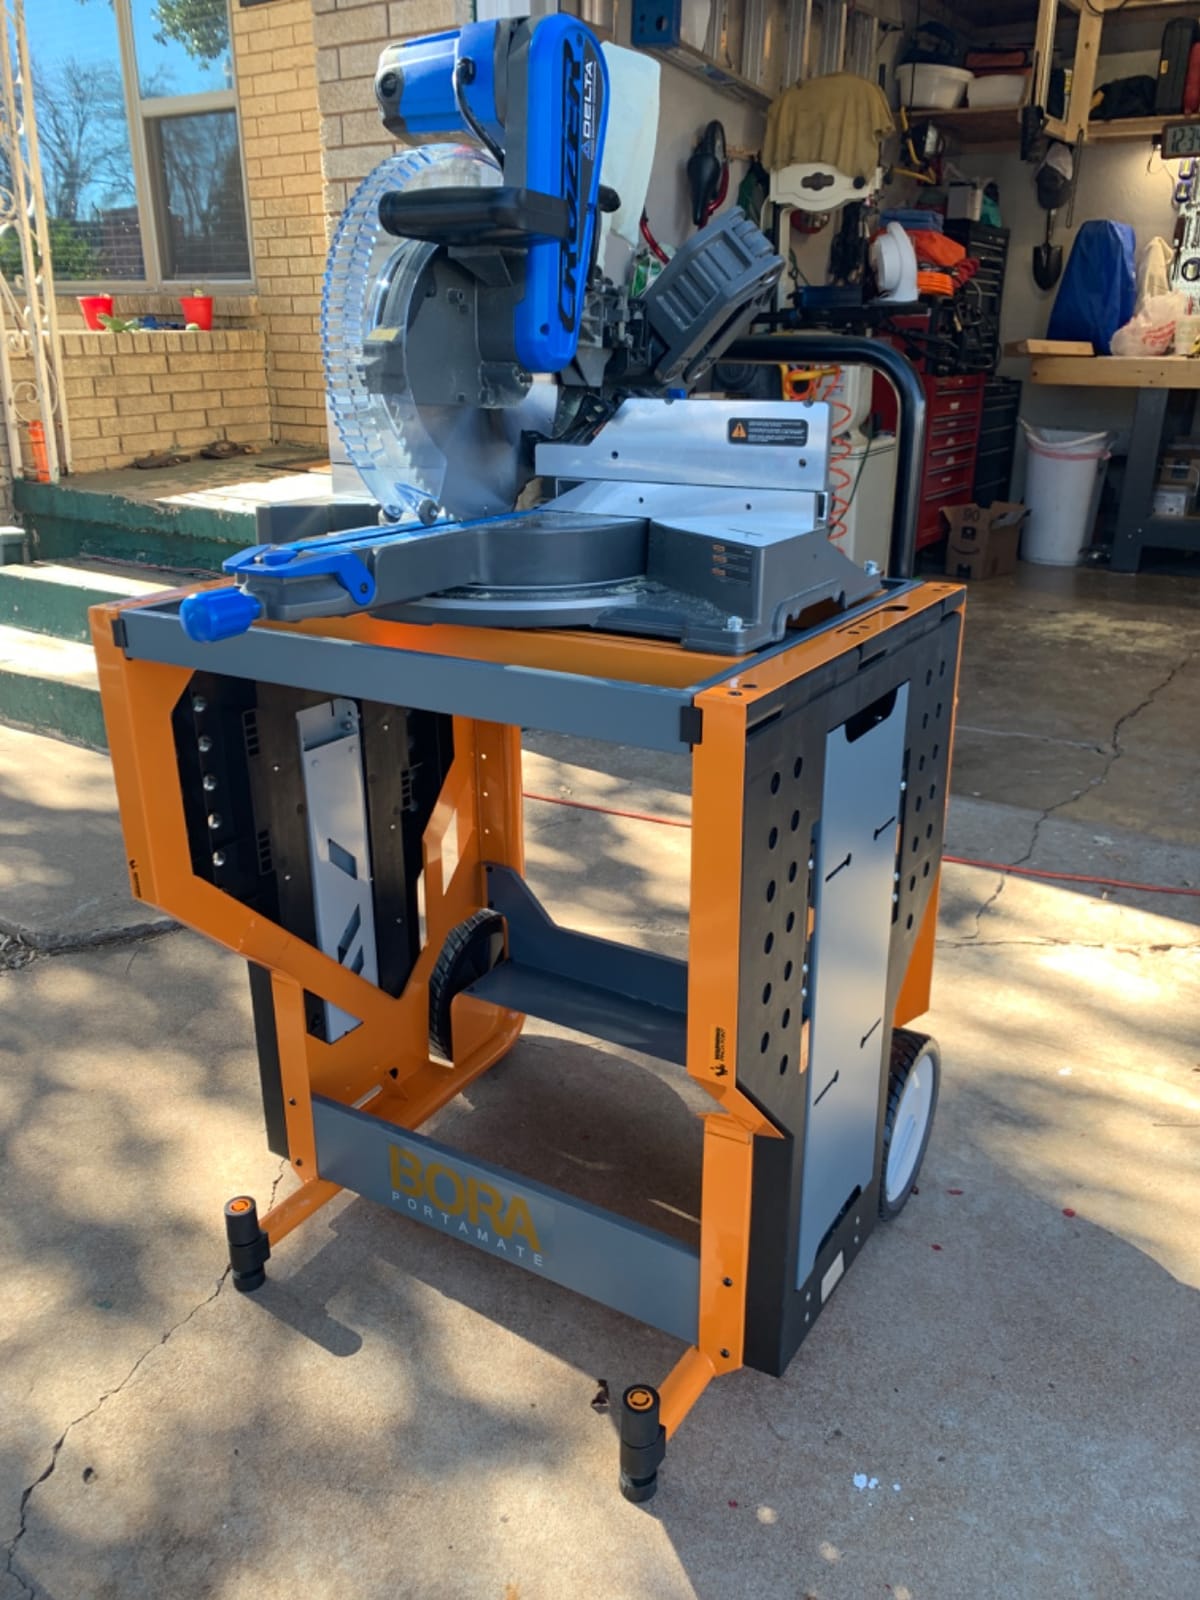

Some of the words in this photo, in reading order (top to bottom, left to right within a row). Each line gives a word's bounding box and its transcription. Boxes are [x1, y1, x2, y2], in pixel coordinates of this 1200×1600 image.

[582, 60, 594, 139] DELTA
[388, 1143, 542, 1252] BORA
[391, 1190, 545, 1268] PORTAMATE
